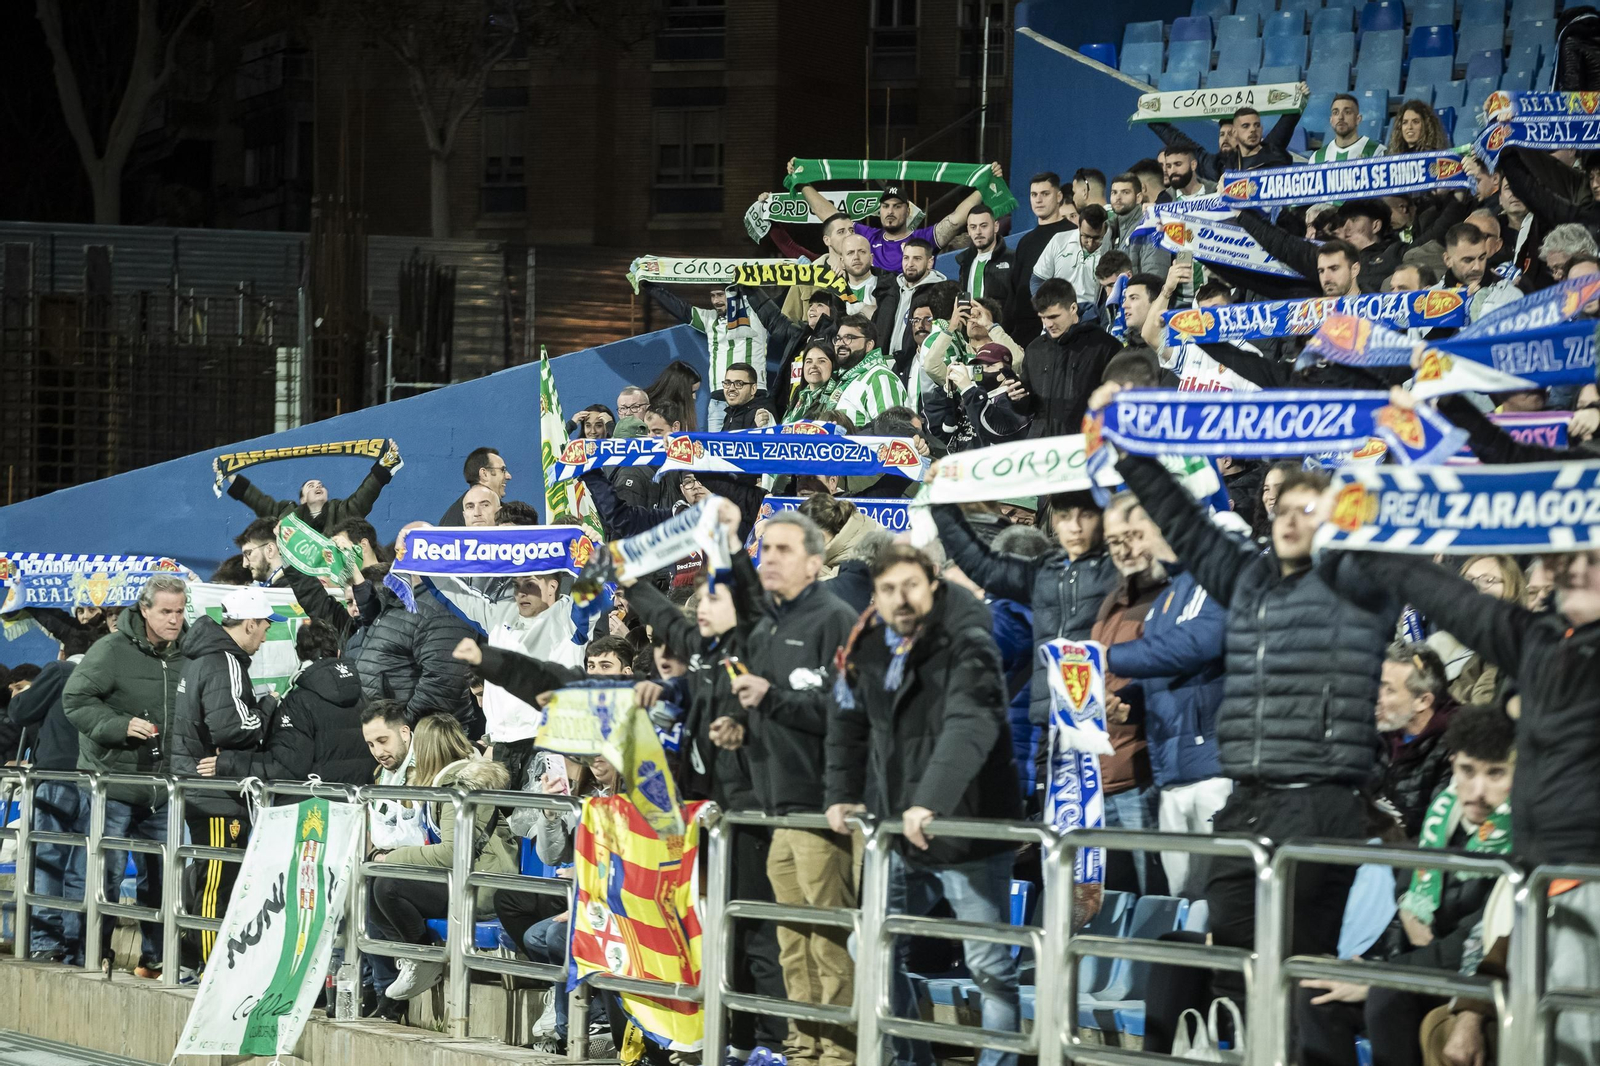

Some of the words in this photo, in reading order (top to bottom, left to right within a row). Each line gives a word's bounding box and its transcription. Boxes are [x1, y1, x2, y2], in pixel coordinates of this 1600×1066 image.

[1173, 90, 1255, 109] CÓRDOBA
[1519, 96, 1567, 113] REAL
[1523, 122, 1578, 142] REAL
[1259, 171, 1324, 199] ZARAGOZA
[1326, 166, 1370, 192] NUNCA
[1371, 163, 1387, 187] SE
[1389, 159, 1427, 185] RINDE
[852, 198, 878, 215] CF
[750, 206, 768, 233] 1954
[1197, 227, 1256, 248] Donde
[1198, 243, 1214, 252] Real
[1215, 246, 1250, 259] Zaragoza
[673, 259, 737, 275] CÓRDO
[743, 264, 849, 293] RAGOZA
[1216, 304, 1278, 332] REAL
[1286, 292, 1411, 327] ZARAGOZA
[1491, 339, 1563, 375] REAL
[1116, 401, 1194, 440] REAL
[1197, 401, 1357, 440] ZARAGOZA
[599, 439, 650, 453] REAL
[708, 441, 760, 460] REAL
[761, 440, 873, 463] ZARAGOZA
[972, 448, 1088, 480] CÓRDO
[1379, 490, 1444, 529] REAL
[1443, 488, 1600, 530] ZARAGOZ
[412, 538, 460, 561] Real
[464, 538, 566, 565] Zaragoza
[32, 577, 63, 586] club
[25, 587, 74, 602] REAL
[108, 586, 143, 602] ZARA
